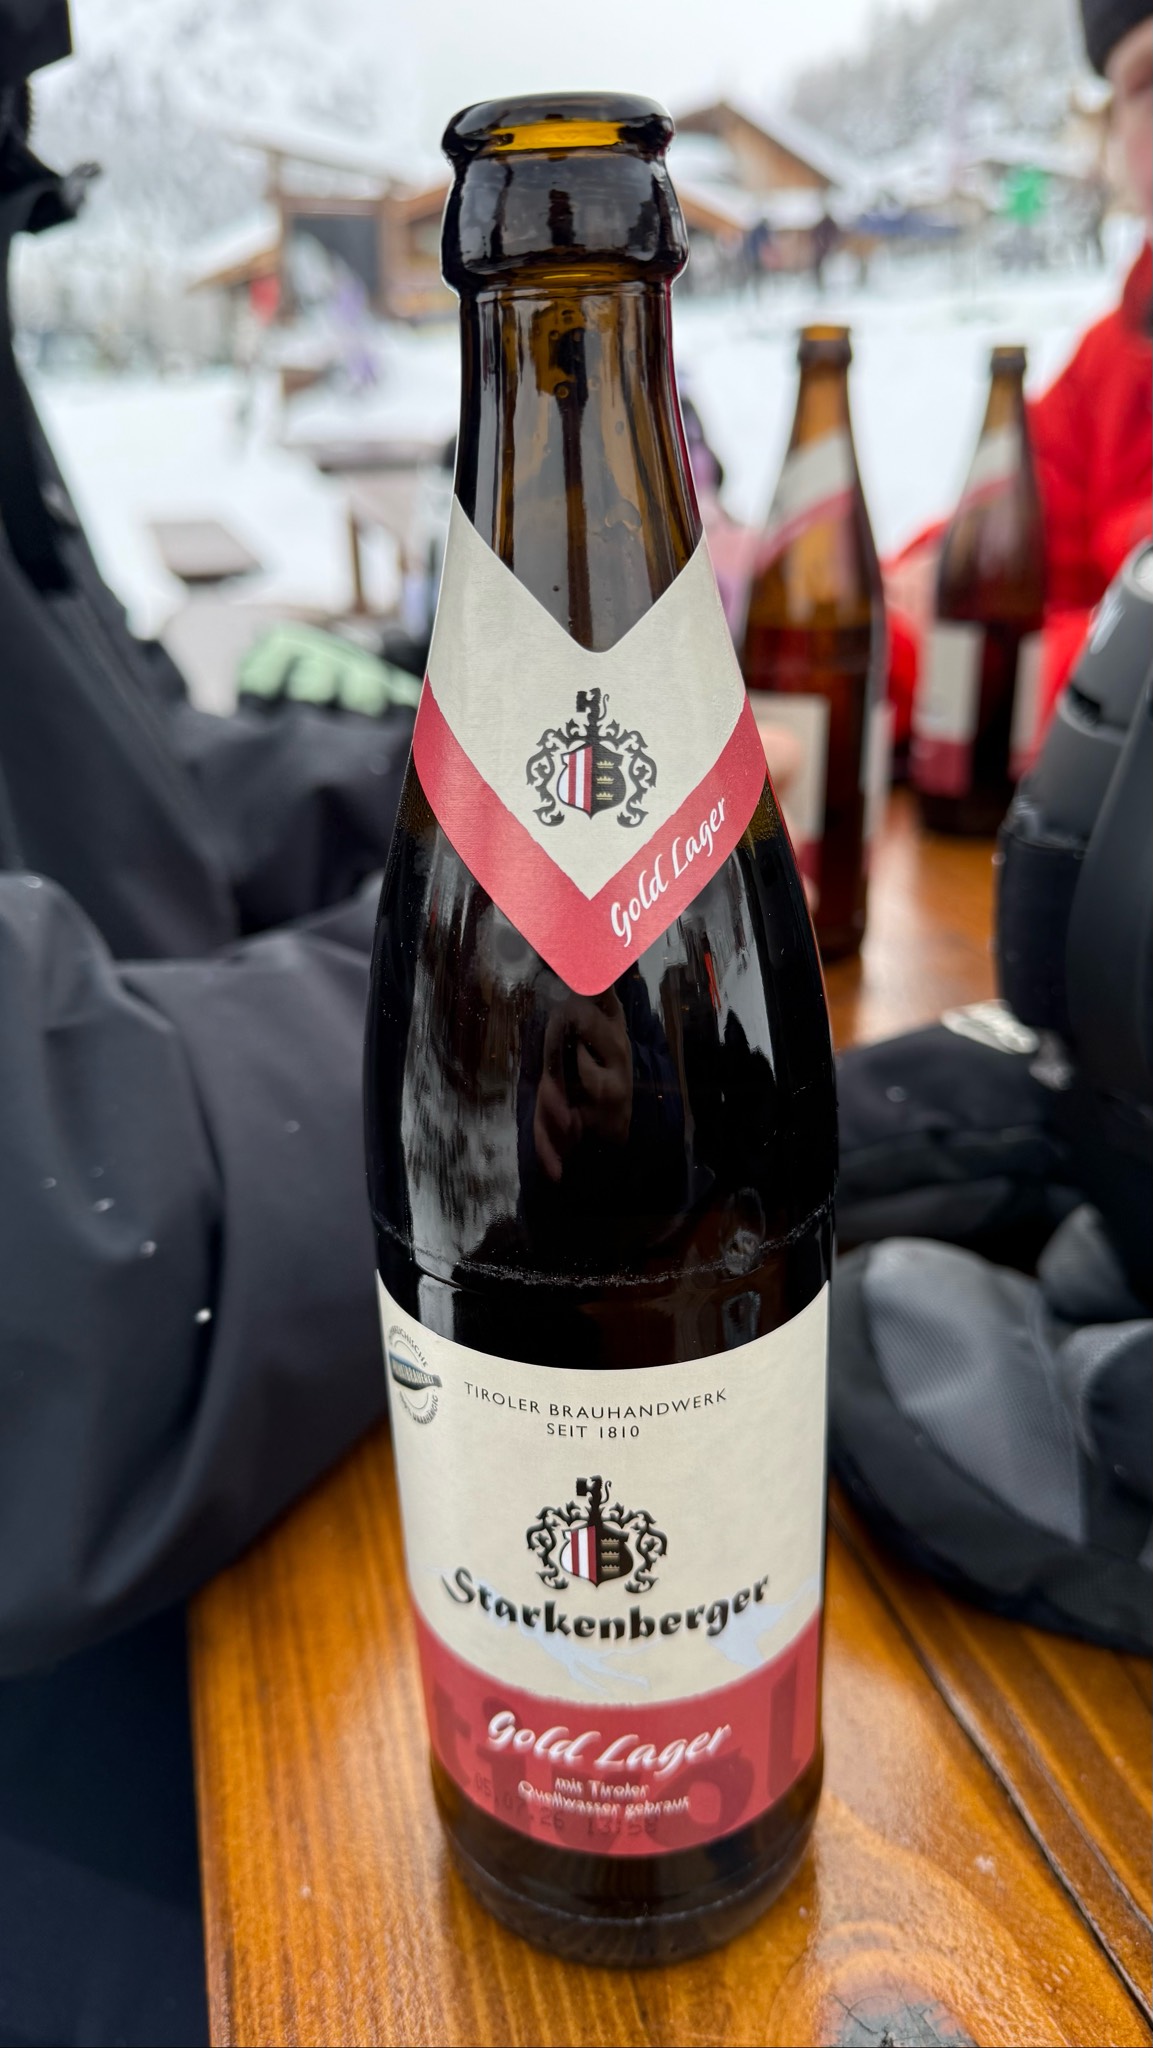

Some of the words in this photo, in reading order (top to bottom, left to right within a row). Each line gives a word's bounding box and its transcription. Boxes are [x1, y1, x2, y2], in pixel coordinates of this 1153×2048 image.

[611, 853, 669, 948] Gold
[671, 797, 726, 879] Lager
[464, 1380, 541, 1414] TIROLER
[549, 1387, 727, 1420] BRAUHANDWERK
[546, 1422, 588, 1438] SEIT
[599, 1424, 641, 1439] 1810
[441, 1566, 770, 1640] Starkenberger
[487, 1710, 601, 1767] Gold
[593, 1723, 732, 1781] Lager
[517, 1779, 621, 1817] Quellwasser
[624, 1795, 690, 1823] gebraut
[554, 1776, 584, 1796] mit
[588, 1778, 649, 1802] Tiroler
